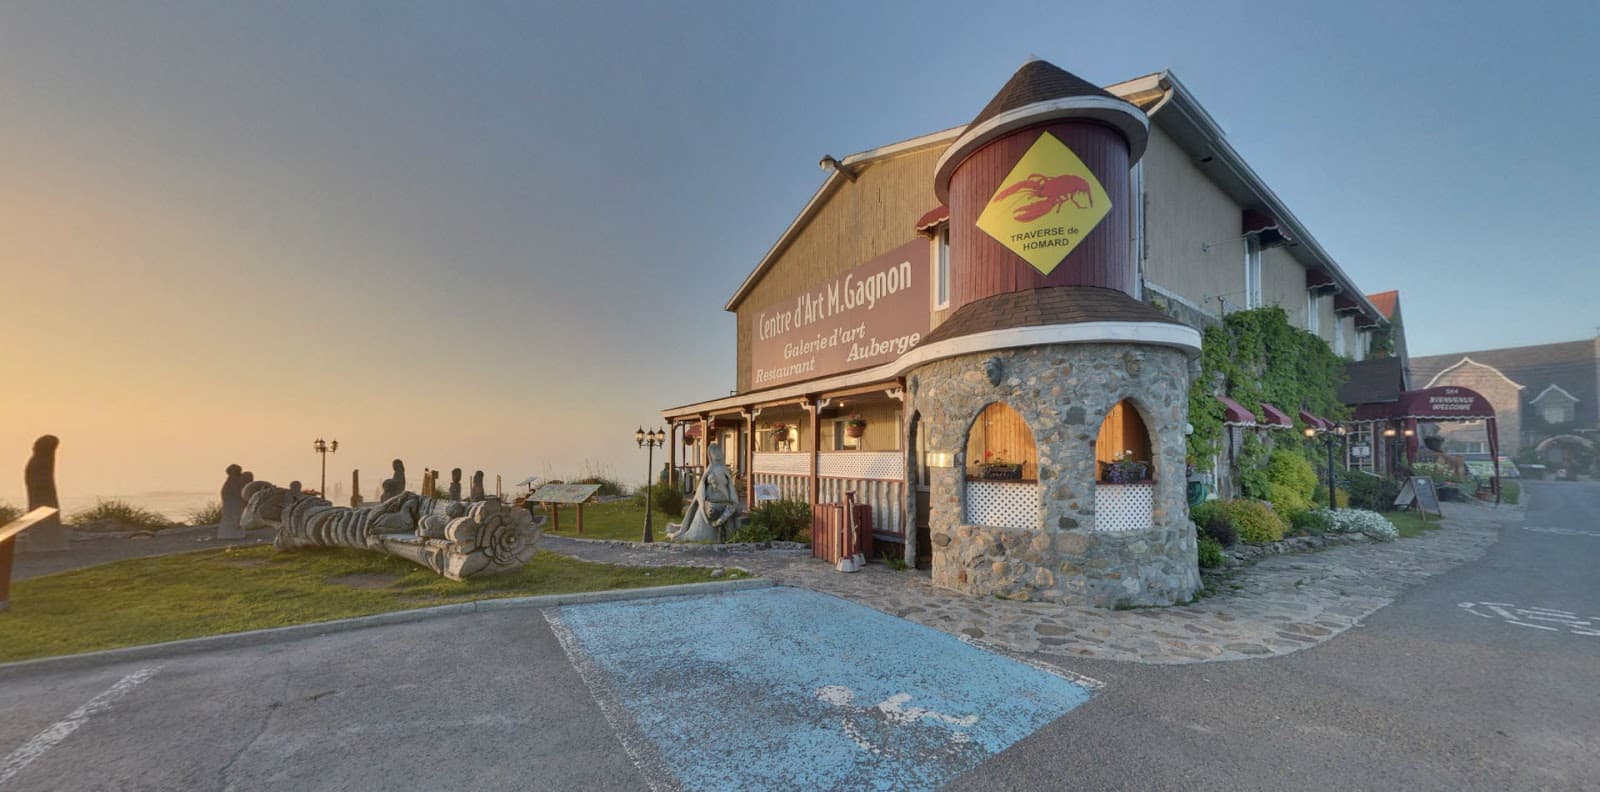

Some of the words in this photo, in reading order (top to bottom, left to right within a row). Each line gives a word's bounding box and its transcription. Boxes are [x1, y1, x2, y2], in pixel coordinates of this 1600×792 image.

[1010, 227, 1065, 242] TRAVERSE
[1023, 238, 1069, 251] HOMARD
[759, 311, 792, 341] Centre
[794, 292, 825, 328] d'Art
[756, 357, 815, 383] Restaurant
[846, 332, 921, 362] Auberge
[784, 334, 827, 359] Galerie
[828, 321, 866, 347] d'art
